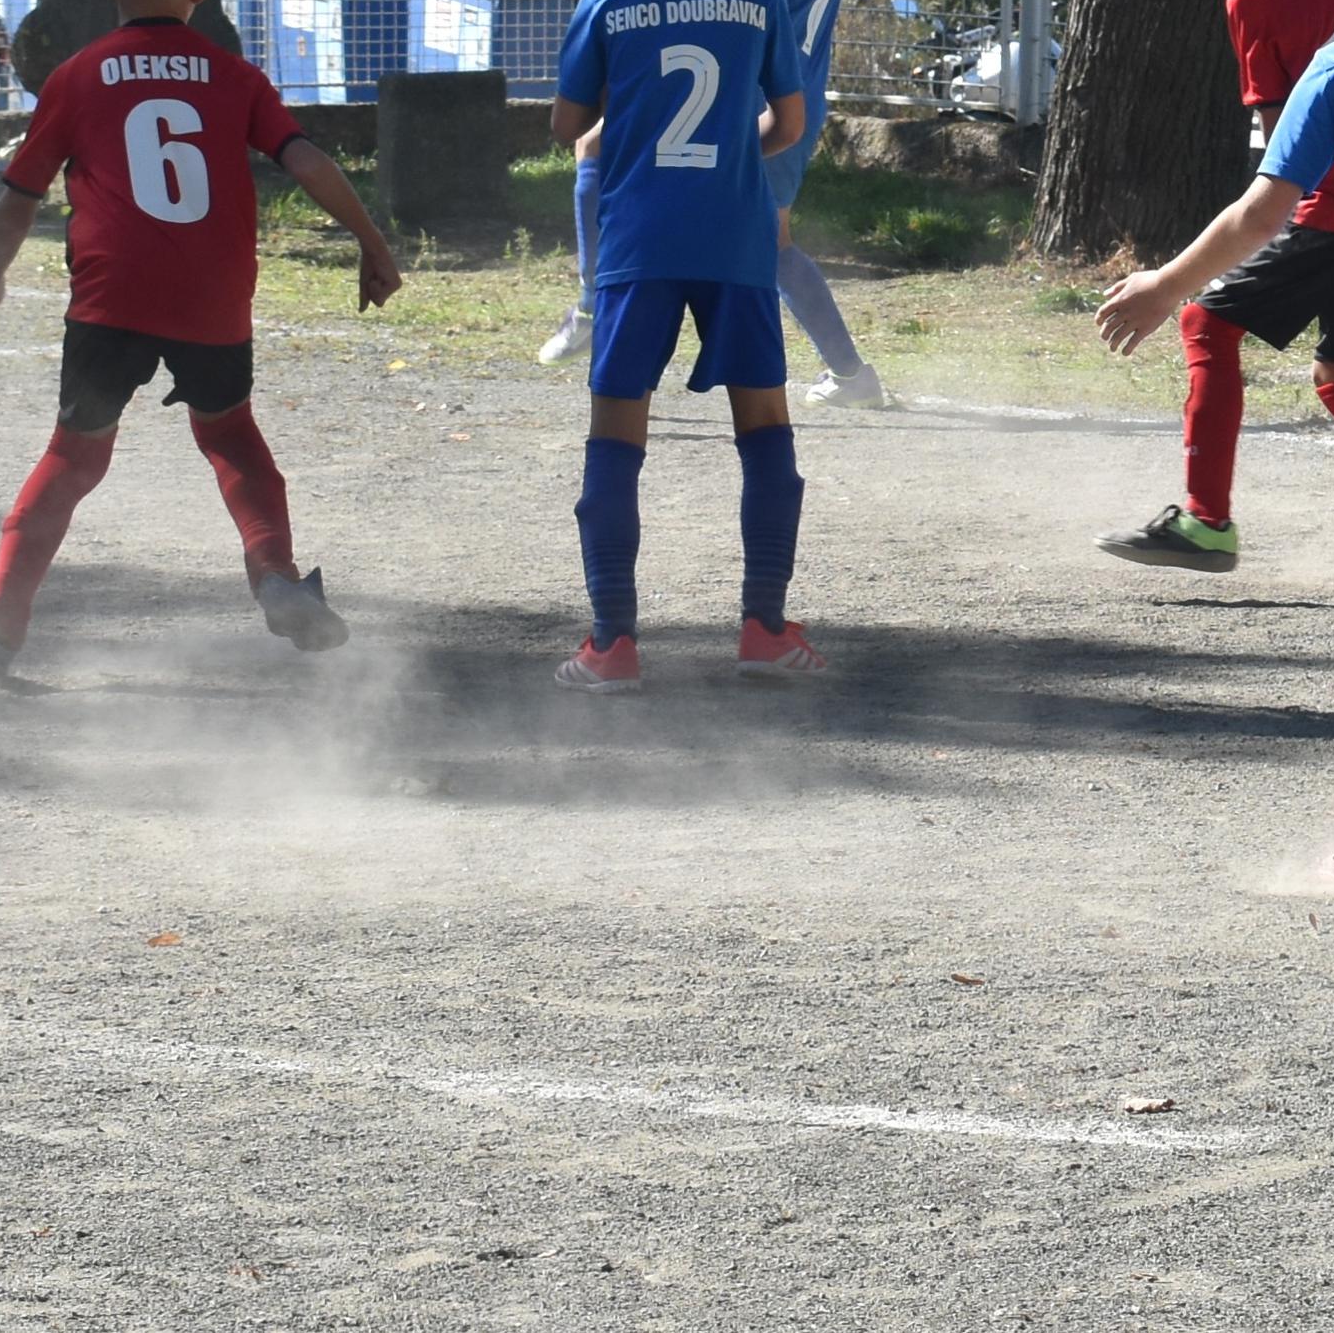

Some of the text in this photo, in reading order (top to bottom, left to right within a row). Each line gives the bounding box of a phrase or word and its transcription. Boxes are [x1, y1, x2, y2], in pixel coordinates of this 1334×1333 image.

[605, 2, 661, 36] SENCO
[100, 55, 210, 86] OLEKSII
[654, 43, 721, 168] 2
[123, 98, 210, 224] 6
